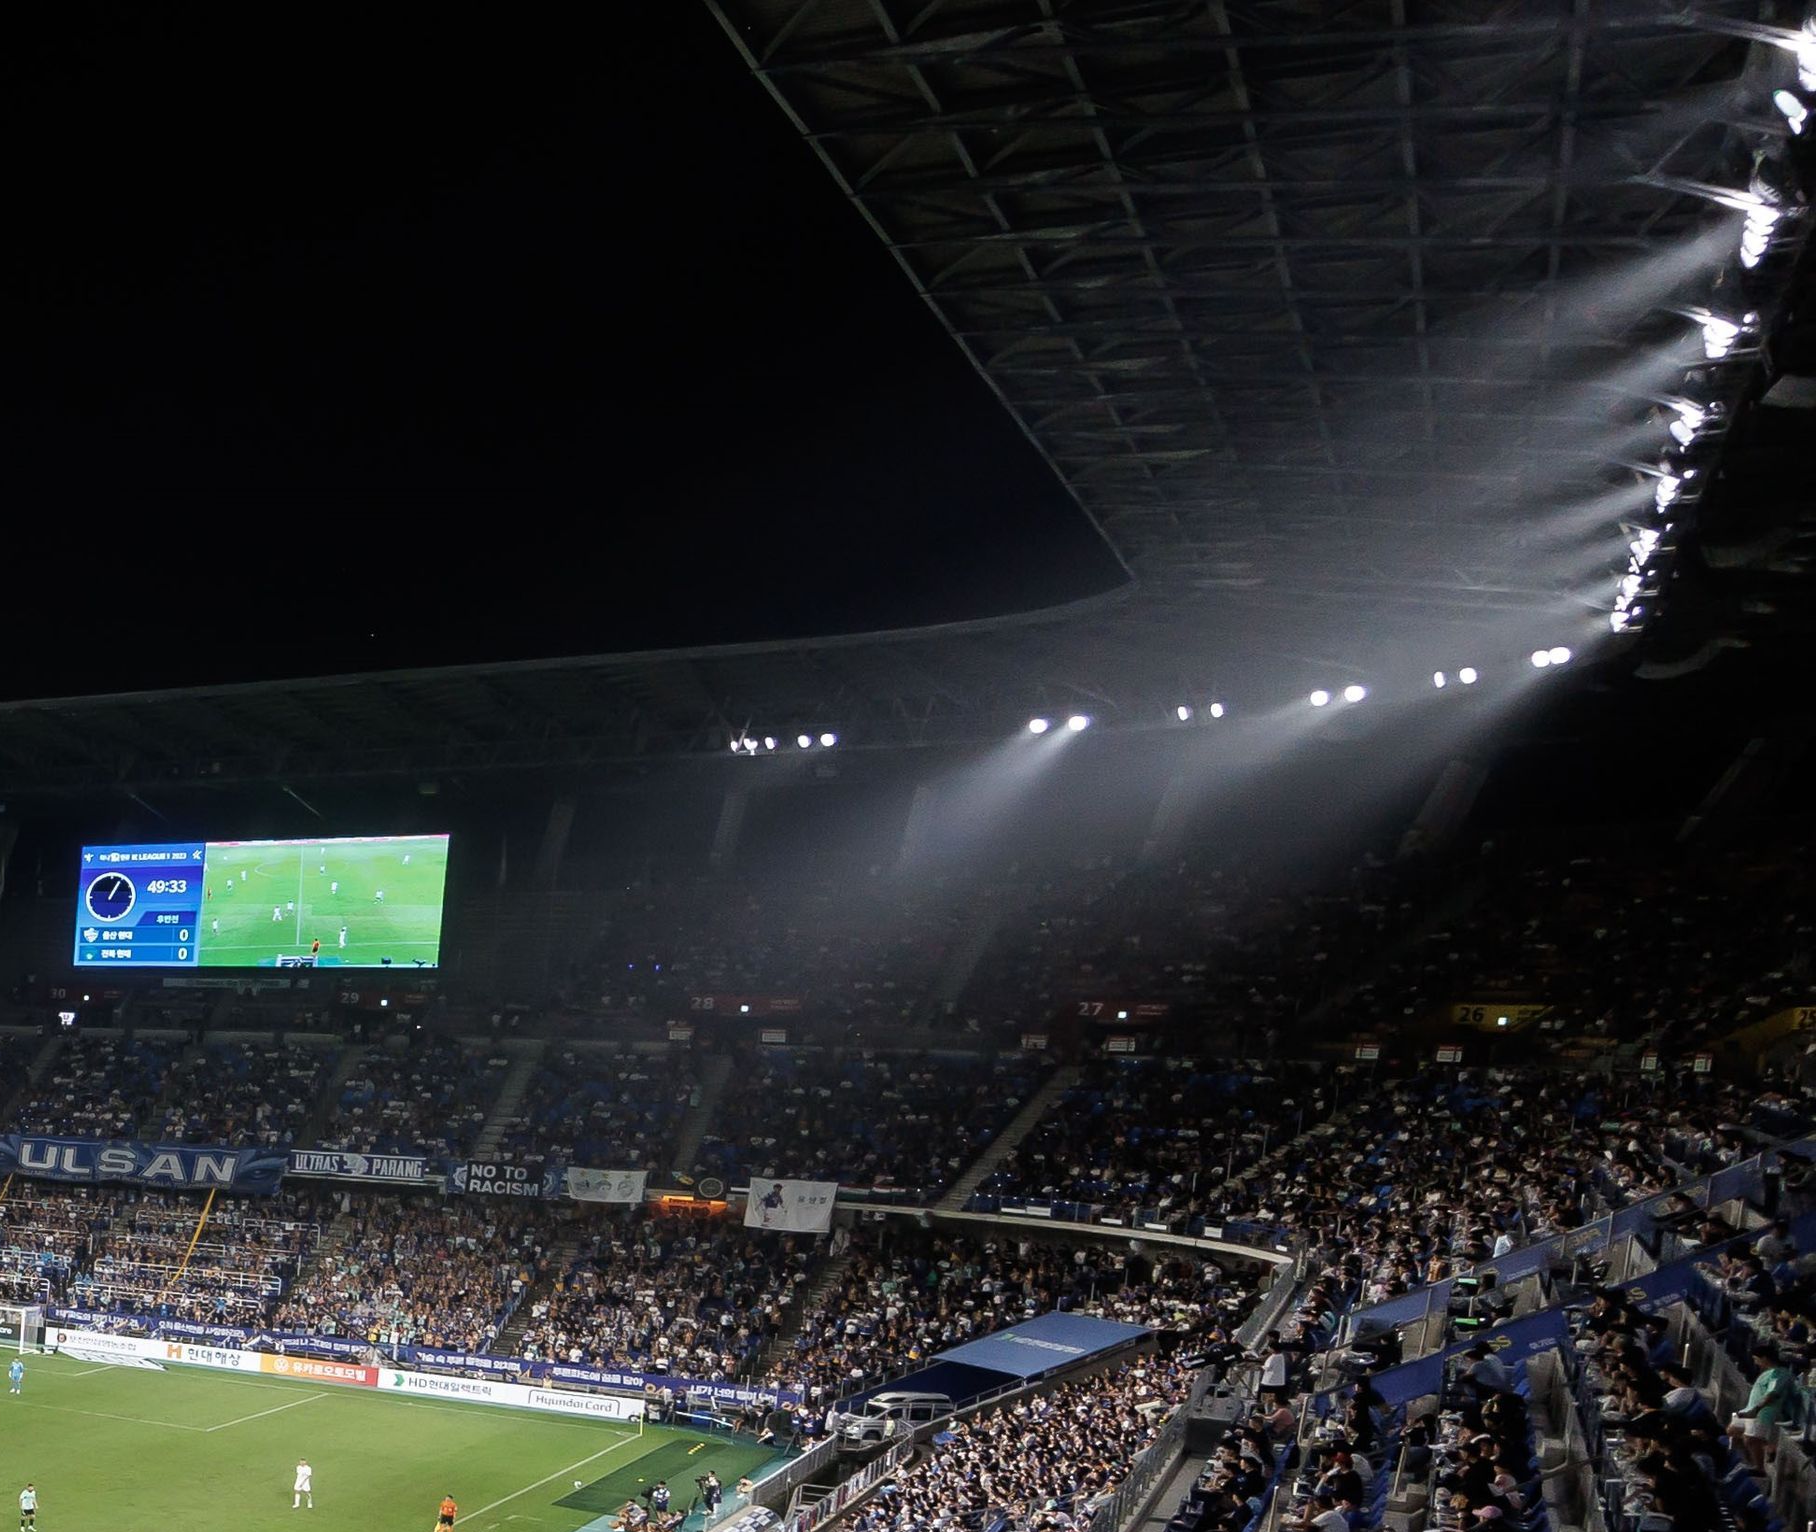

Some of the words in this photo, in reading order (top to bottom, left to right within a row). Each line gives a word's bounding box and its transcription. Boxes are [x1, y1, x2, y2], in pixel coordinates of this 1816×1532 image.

[146, 879, 187, 894] 49:33
[179, 928, 189, 942] 0
[178, 947, 188, 960] 0
[50, 988, 66, 1000] 30
[341, 992, 360, 1004] 29
[691, 997, 715, 1009] 28
[1078, 1002, 1104, 1016] 27
[1459, 1008, 1484, 1023] 26
[20, 1143, 236, 1186] ULSAN
[295, 1154, 340, 1173] ULTRAS
[372, 1158, 423, 1179] PARANG
[470, 1164, 496, 1177] NO
[504, 1167, 528, 1180] TO
[469, 1181, 540, 1197] RACISM
[188, 1347, 241, 1367] 현대해상
[292, 1361, 366, 1382] 유카로오토모빌
[408, 1376, 493, 1396] HD현대일렉트릭
[535, 1394, 584, 1410] Hyundai
[584, 1400, 613, 1413] Card
